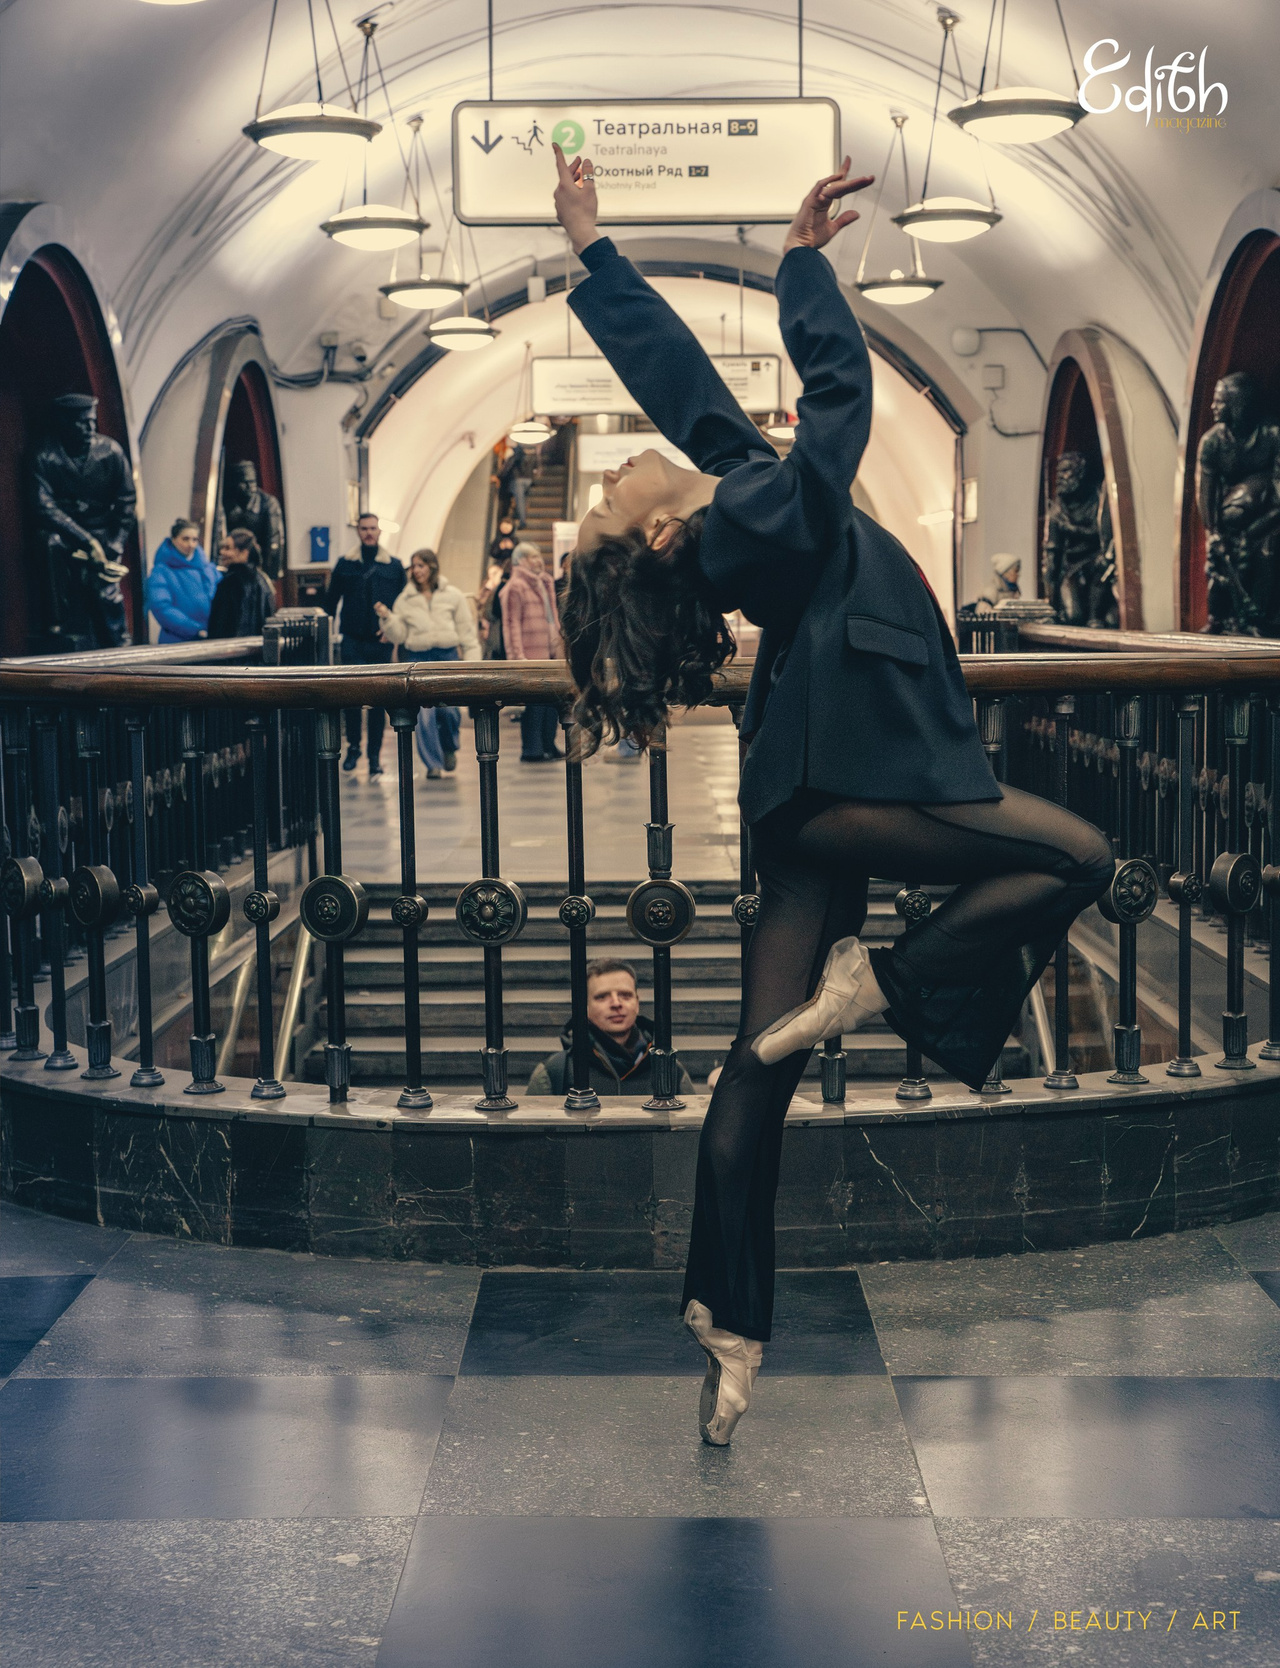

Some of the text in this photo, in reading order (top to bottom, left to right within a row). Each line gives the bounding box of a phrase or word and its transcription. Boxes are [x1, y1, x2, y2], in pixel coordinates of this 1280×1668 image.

[593, 119, 757, 138] Театральная 8-9
[561, 126, 576, 148] 2
[593, 144, 668, 157] Teatralnaya
[594, 165, 653, 177] Охотный
[658, 165, 683, 177] Ряд
[634, 181, 657, 191] Ryad
